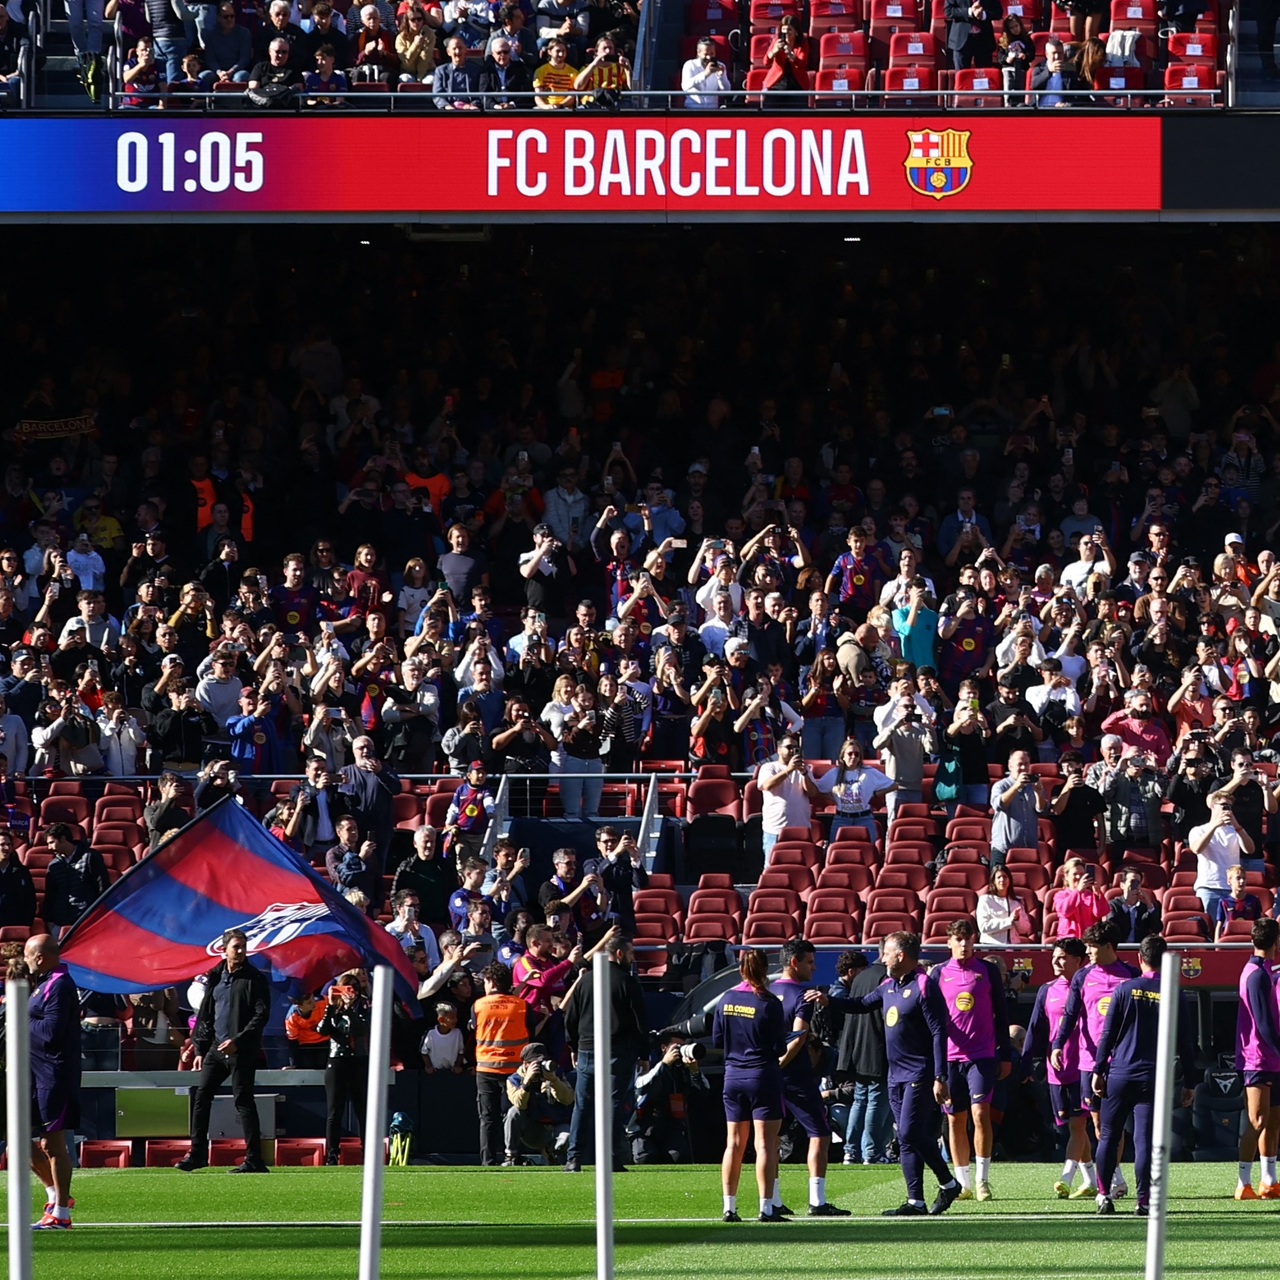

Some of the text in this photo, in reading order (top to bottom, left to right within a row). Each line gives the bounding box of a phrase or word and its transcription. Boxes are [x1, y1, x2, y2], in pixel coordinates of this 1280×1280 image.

[117, 131, 264, 193] 01:05
[487, 128, 869, 197] FC BARCELONA
[925, 158, 952, 167] FCB
[22, 417, 94, 434] BARCELONA
[734, 1004, 756, 1015] CONGO
